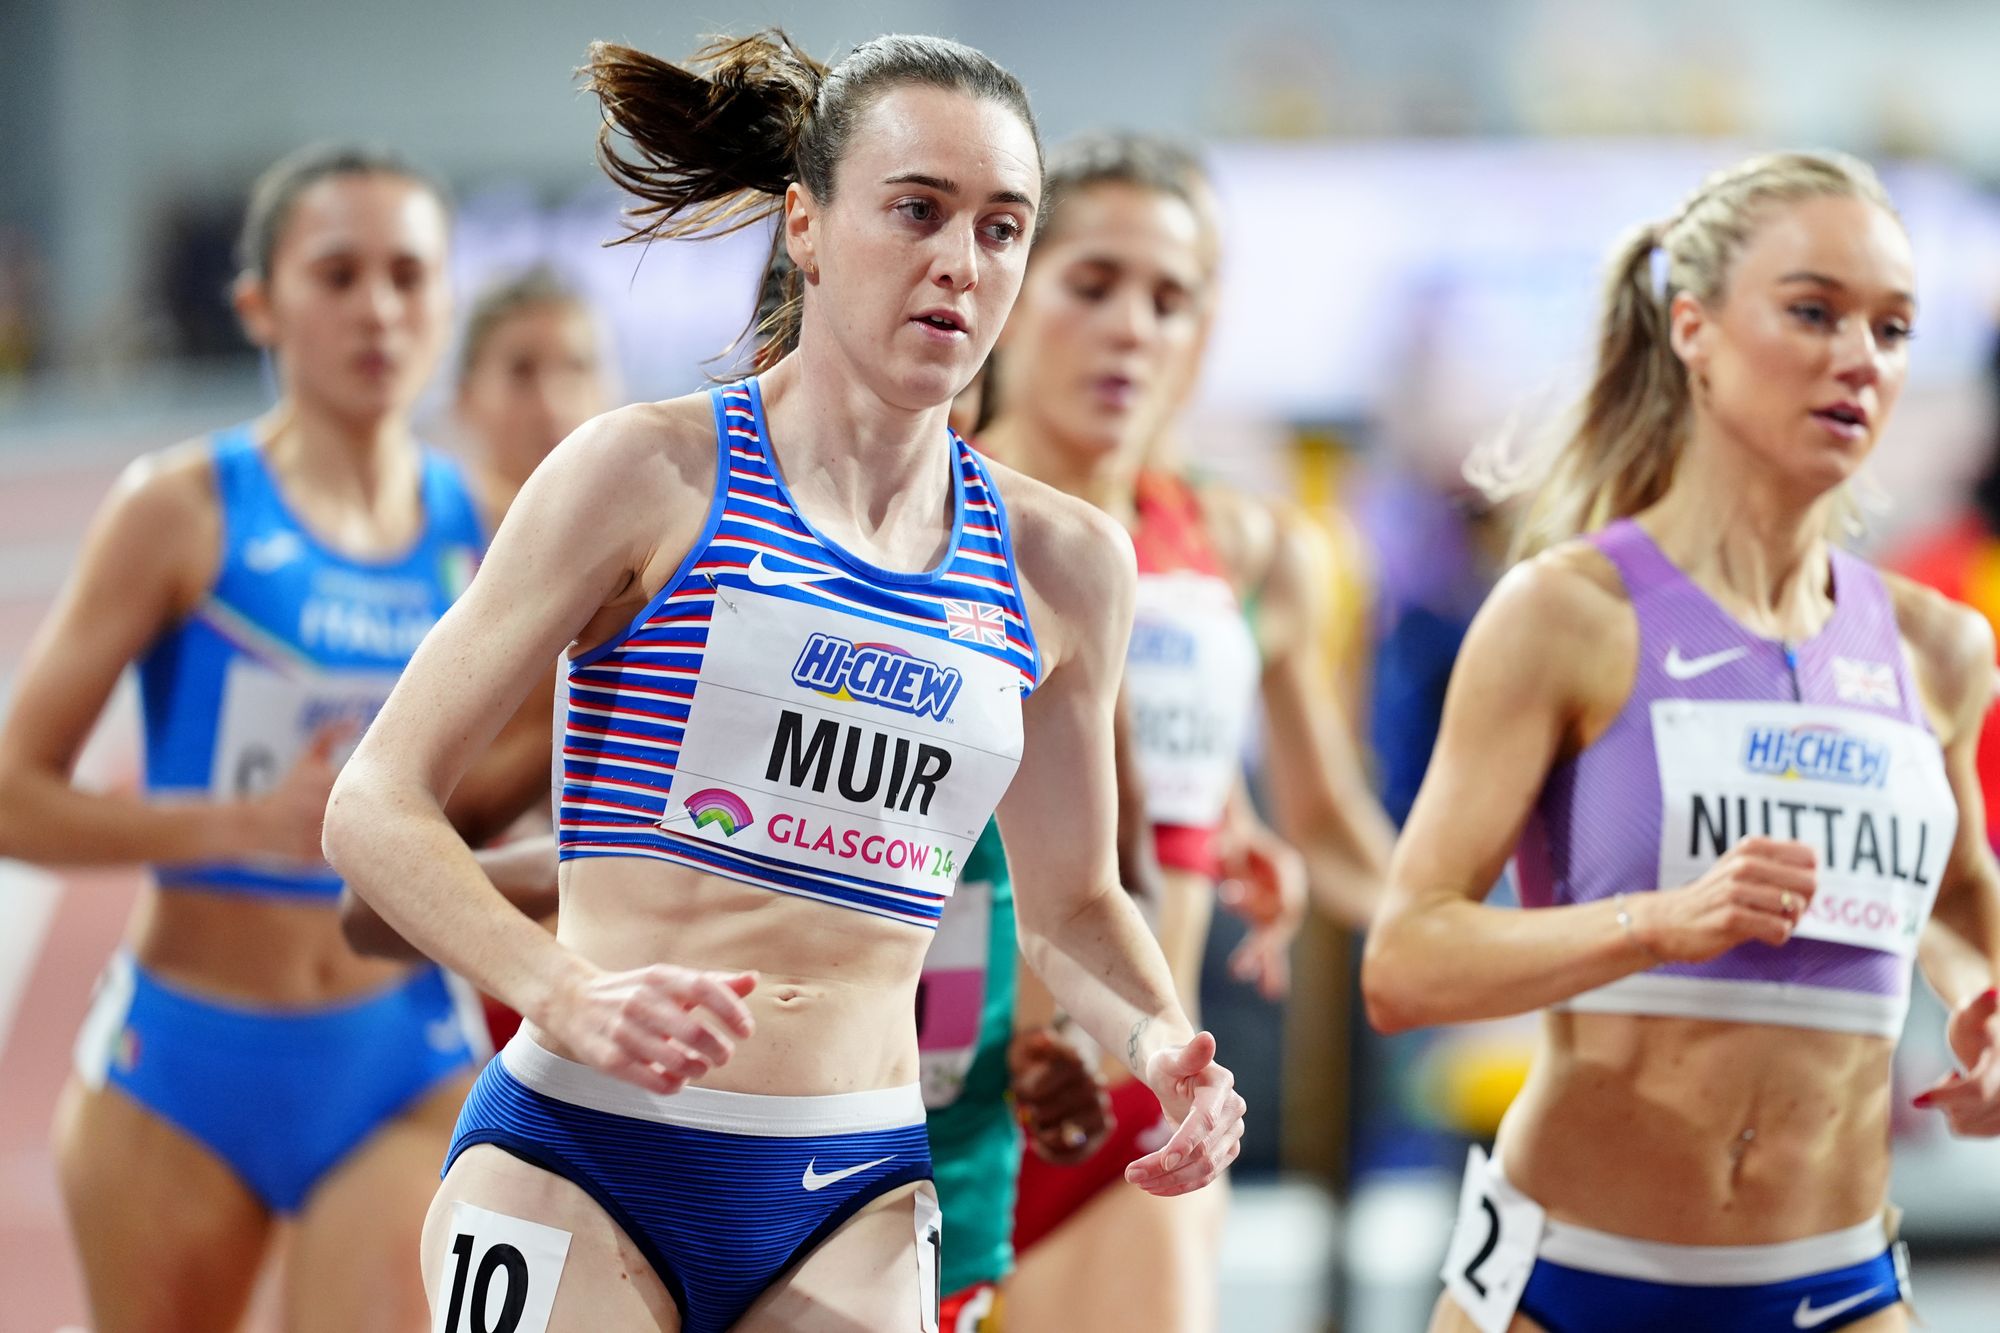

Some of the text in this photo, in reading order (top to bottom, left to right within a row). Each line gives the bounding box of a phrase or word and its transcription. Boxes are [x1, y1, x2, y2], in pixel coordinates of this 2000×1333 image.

[793, 633, 961, 721] HI-CHEW
[765, 709, 952, 816] MUIR
[767, 813, 930, 873] GLASGOW
[1690, 795, 1928, 885] NUTTALL
[444, 1233, 529, 1333] 10
[1464, 1195, 1500, 1297] 2
